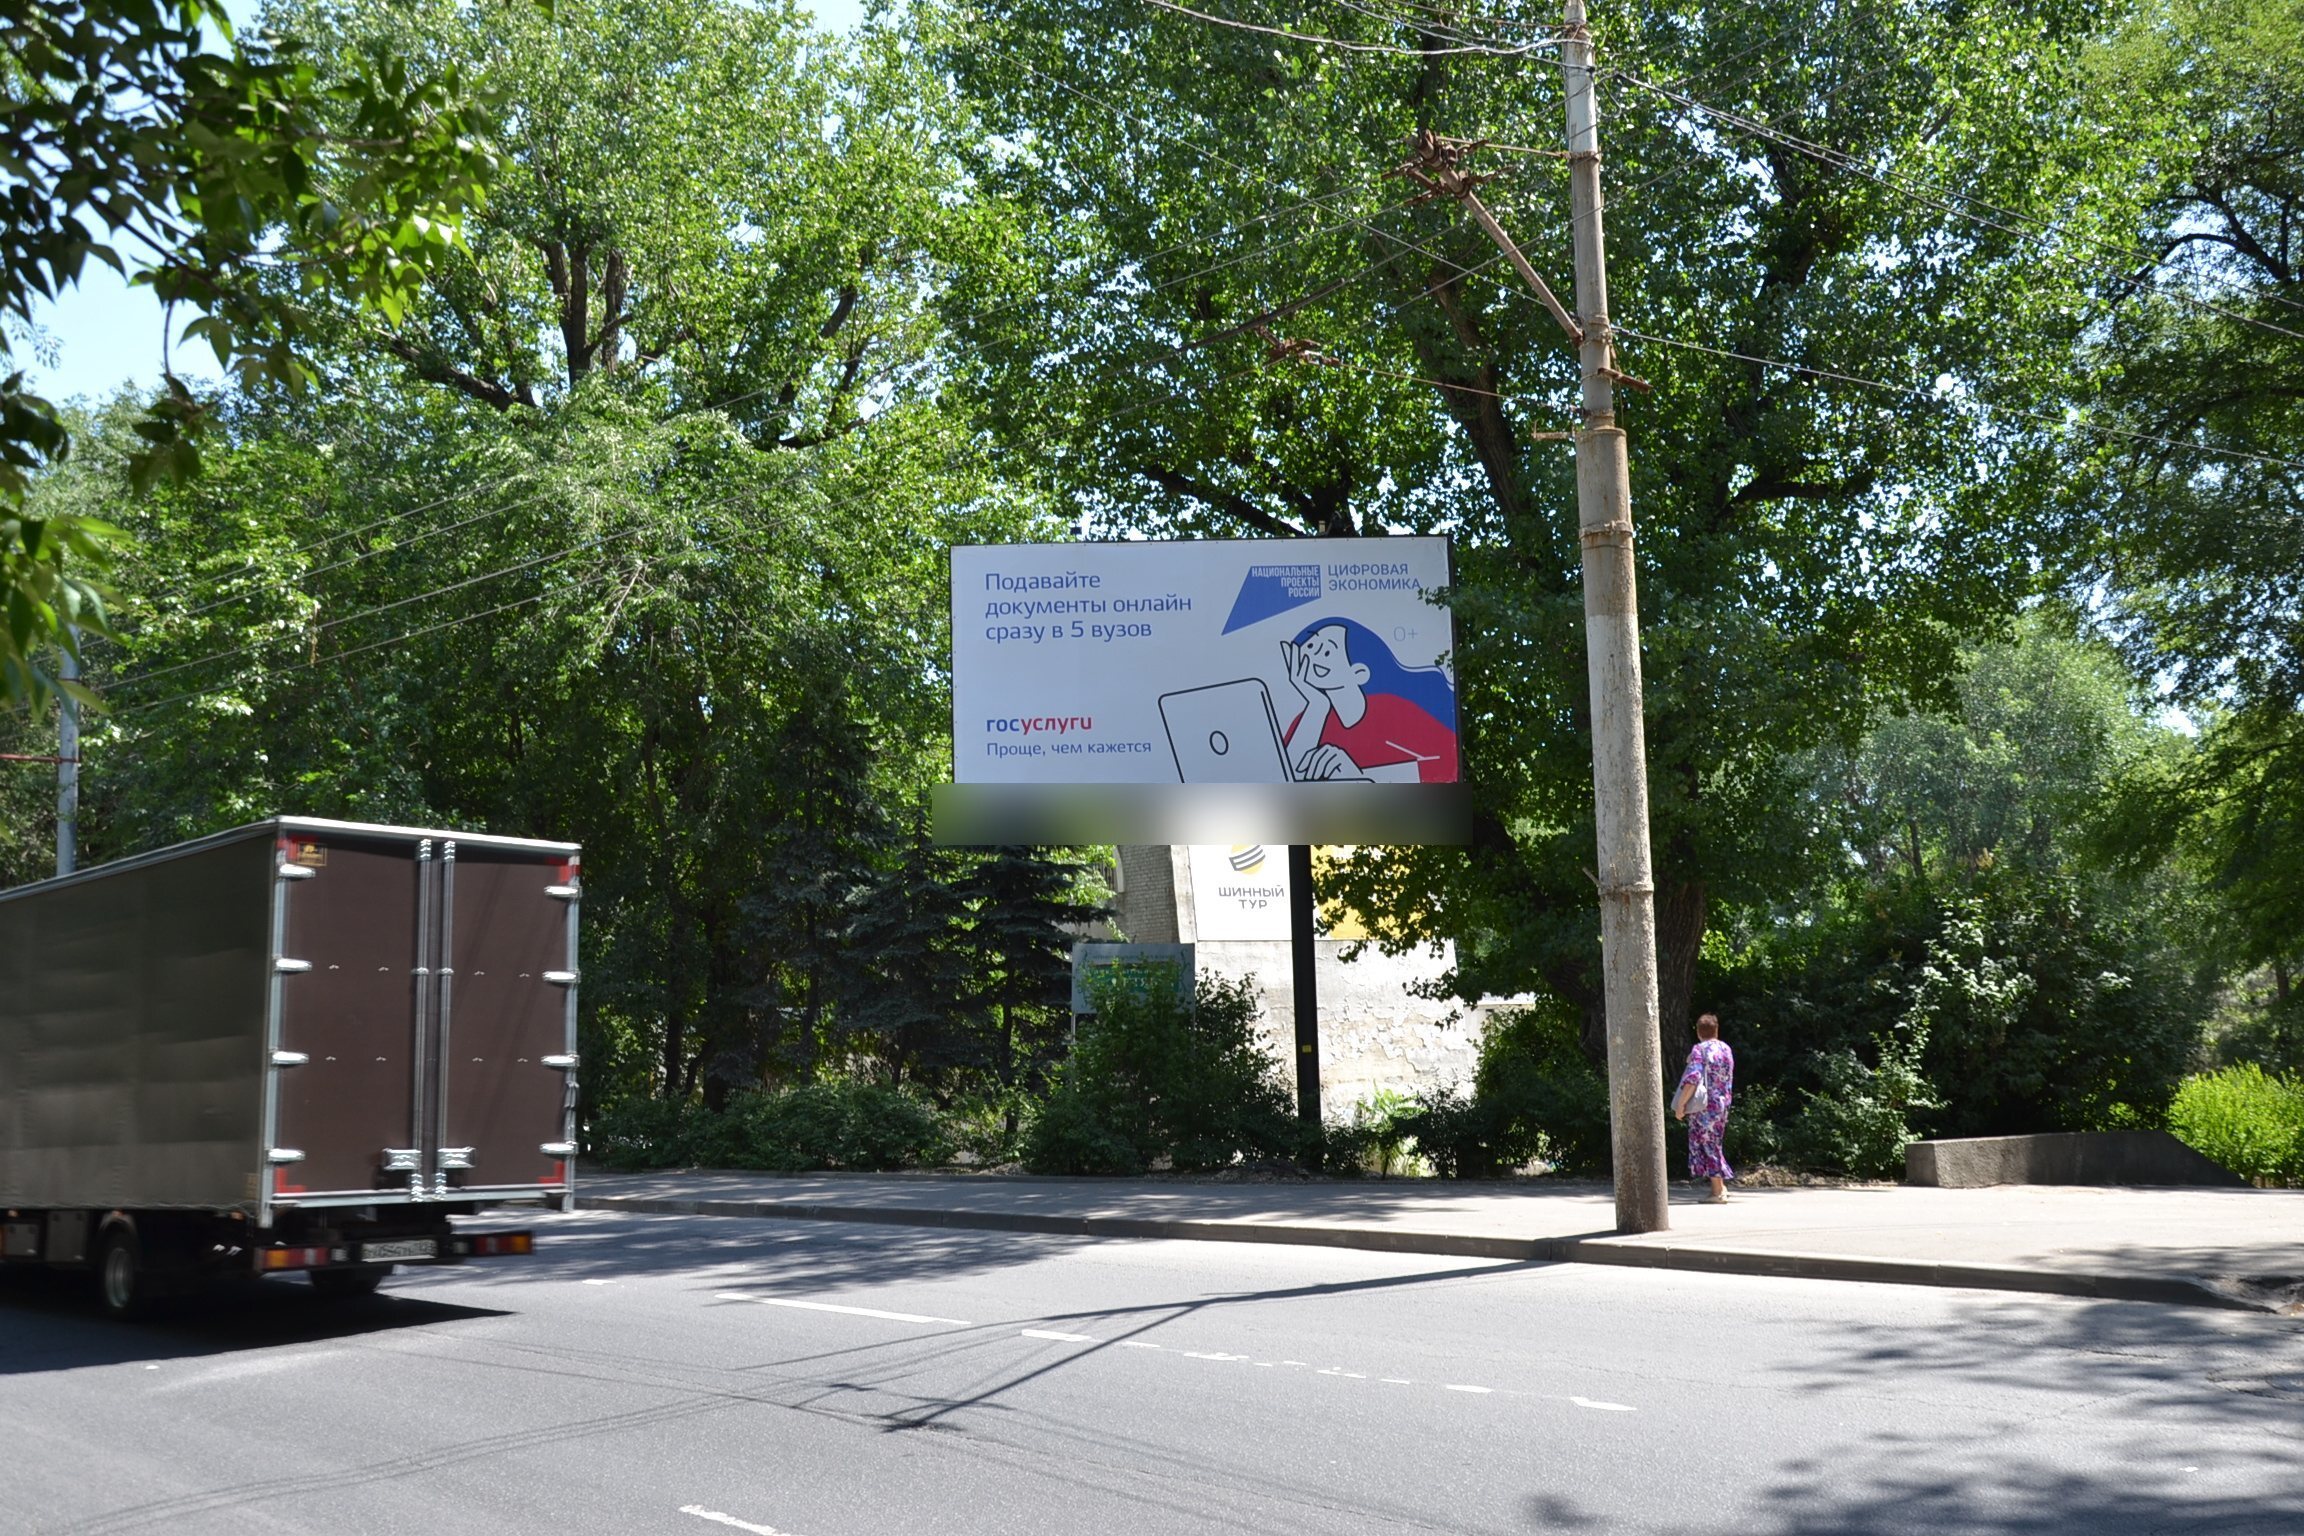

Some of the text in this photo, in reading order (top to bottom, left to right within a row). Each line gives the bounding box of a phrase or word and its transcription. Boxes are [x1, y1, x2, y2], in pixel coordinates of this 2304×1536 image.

[1251, 566, 1320, 578] НАЦИОНАЛЬНЫЕ
[1328, 563, 1409, 578] ЦИФРОВАЯ
[985, 571, 1101, 593] Подавайте
[1280, 577, 1320, 587] ПРОЕКТЫ
[1328, 578, 1421, 591] ЭКОНОМИКА
[1288, 587, 1320, 598] РОССИИ
[985, 593, 1192, 619] документы онлайн
[985, 620, 1152, 644] сразу в 5 вузов
[1393, 626, 1419, 642] 0+
[986, 716, 1092, 735] госуслуги
[987, 740, 1152, 759] Проще, чем кажется
[1218, 884, 1285, 898] ШИННЫЙ
[1238, 899, 1268, 910] ТУР
